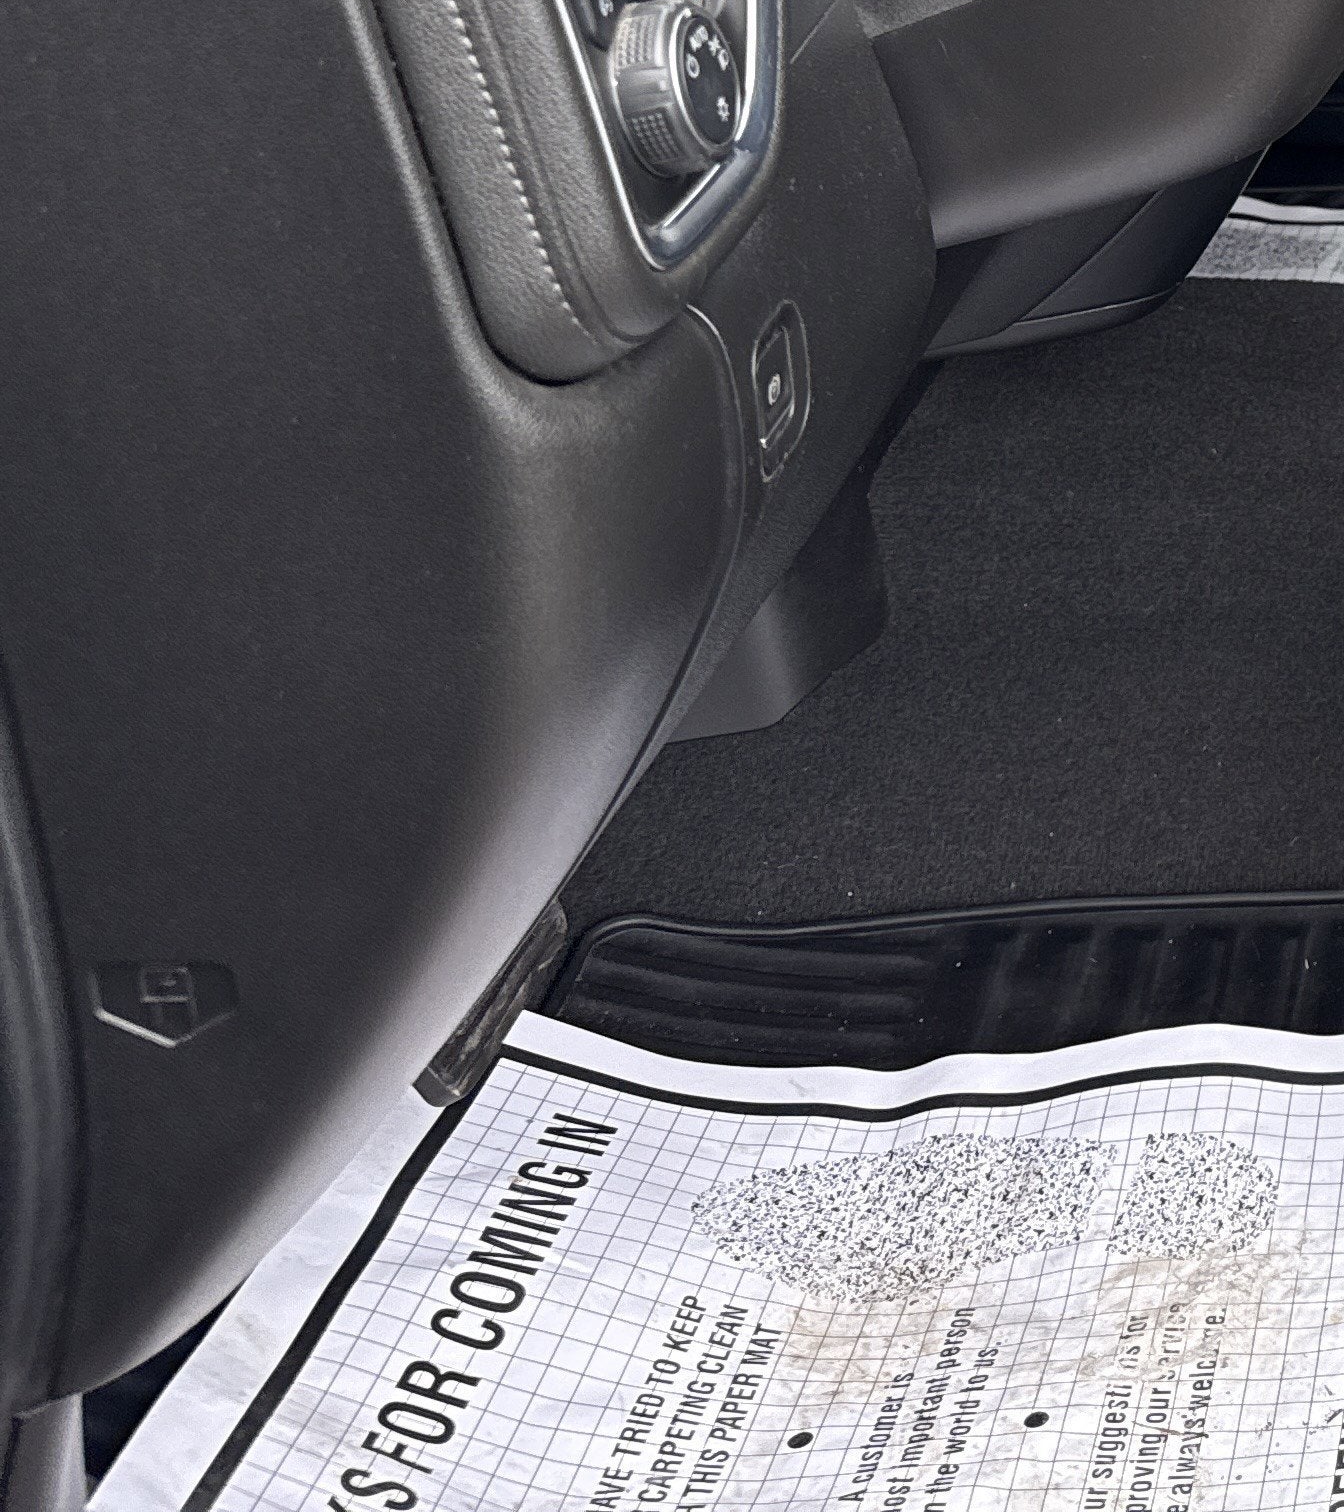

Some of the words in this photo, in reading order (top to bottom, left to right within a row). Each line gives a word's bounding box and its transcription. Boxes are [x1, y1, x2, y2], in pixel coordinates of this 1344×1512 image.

[361, 1360, 481, 1474] FOR
[431, 1161, 593, 1351] COMING
[537, 1113, 619, 1157] IN
[662, 1295, 706, 1353] KEEP
[644, 1358, 681, 1385] TO
[959, 1374, 989, 1393] to
[974, 1342, 1002, 1368] us.
[637, 1380, 718, 1503] CARPETING
[696, 1304, 749, 1375] CLEAN
[682, 1448, 730, 1498] THIS
[709, 1372, 763, 1443] PAPER
[740, 1323, 783, 1366] MAT
[891, 1375, 951, 1469] important
[936, 1307, 976, 1372] person
[1146, 1387, 1172, 1424] our
[611, 1393, 666, 1458] TRIED
[838, 1488, 866, 1502] A
[852, 1396, 906, 1484] customer
[884, 1372, 915, 1389] is
[943, 1400, 981, 1455] world
[925, 1463, 960, 1494] the
